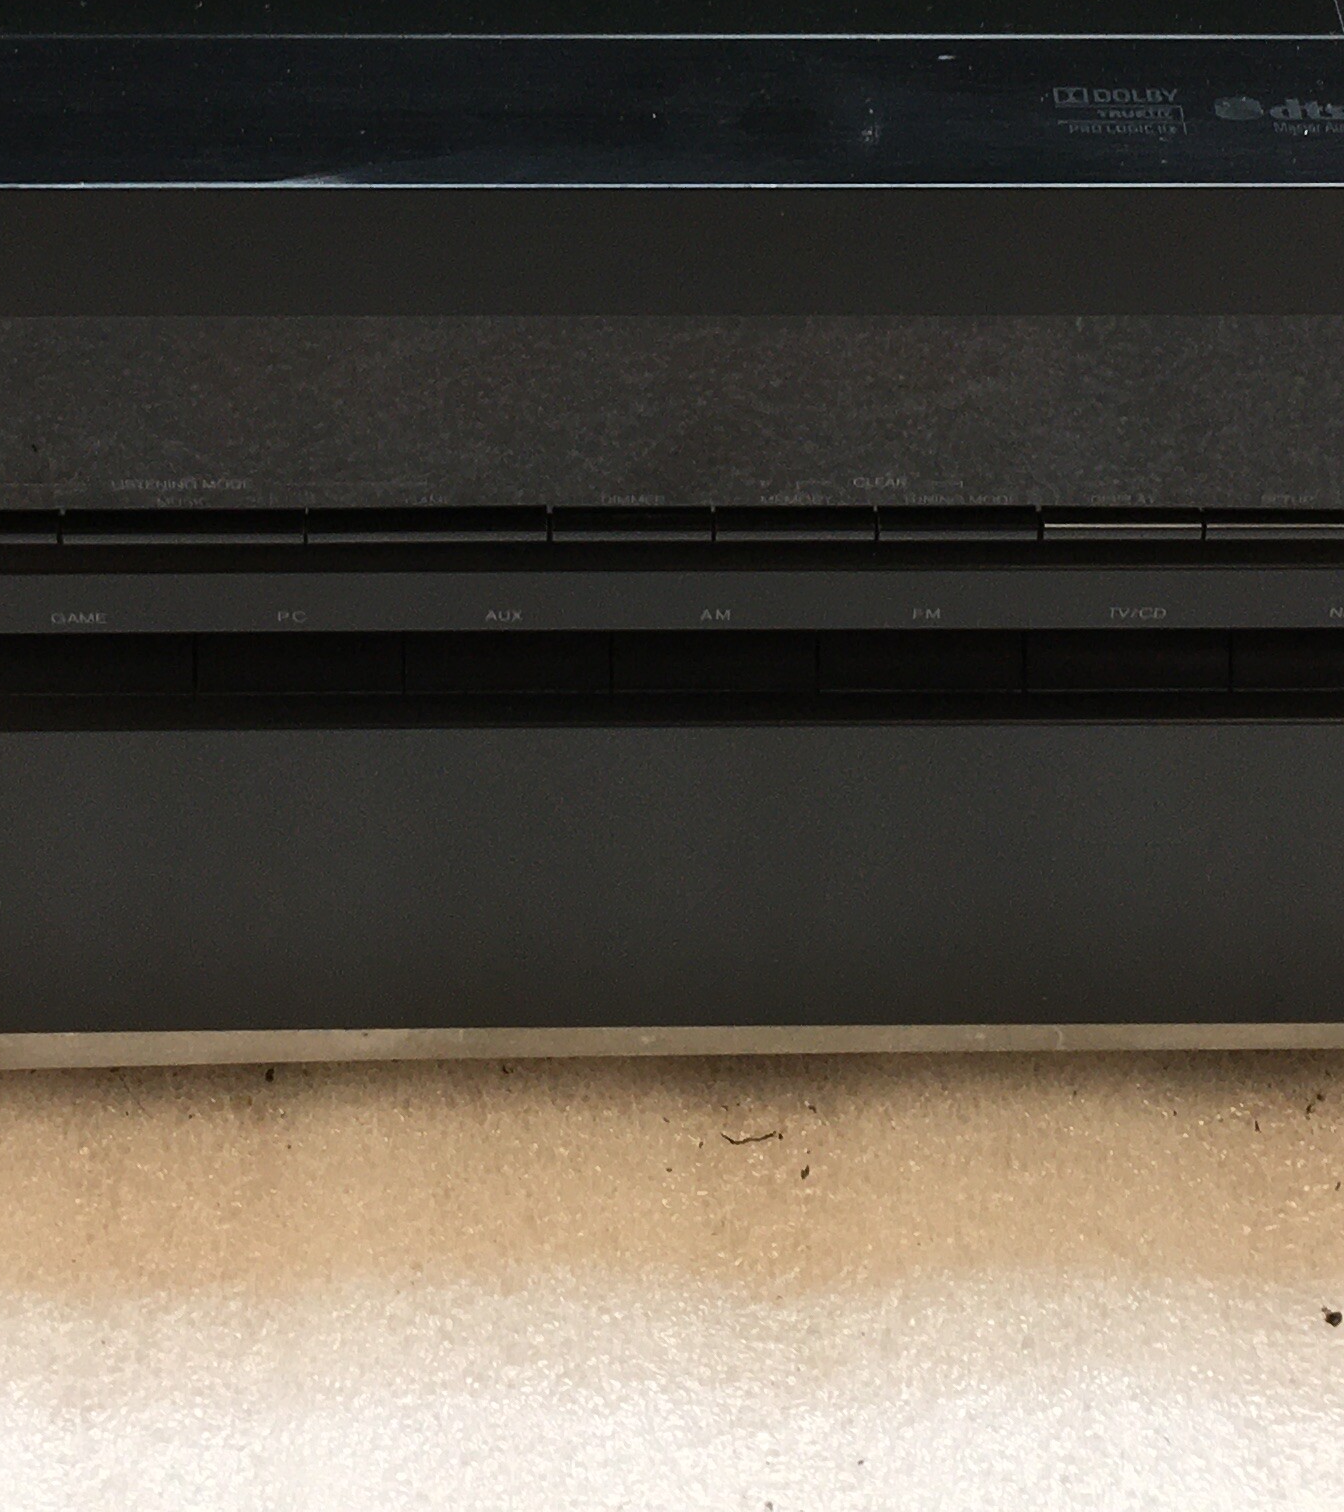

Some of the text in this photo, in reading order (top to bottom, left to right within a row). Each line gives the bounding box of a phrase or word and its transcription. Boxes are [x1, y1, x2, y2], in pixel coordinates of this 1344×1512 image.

[1092, 88, 1178, 103] DOLBY
[852, 476, 907, 489] CLEAR
[50, 612, 109, 625] GAME
[276, 610, 308, 624] PC
[484, 609, 524, 622] AUX
[699, 608, 732, 621] AM
[911, 607, 942, 620] FM
[1108, 606, 1168, 620] TV/CD
